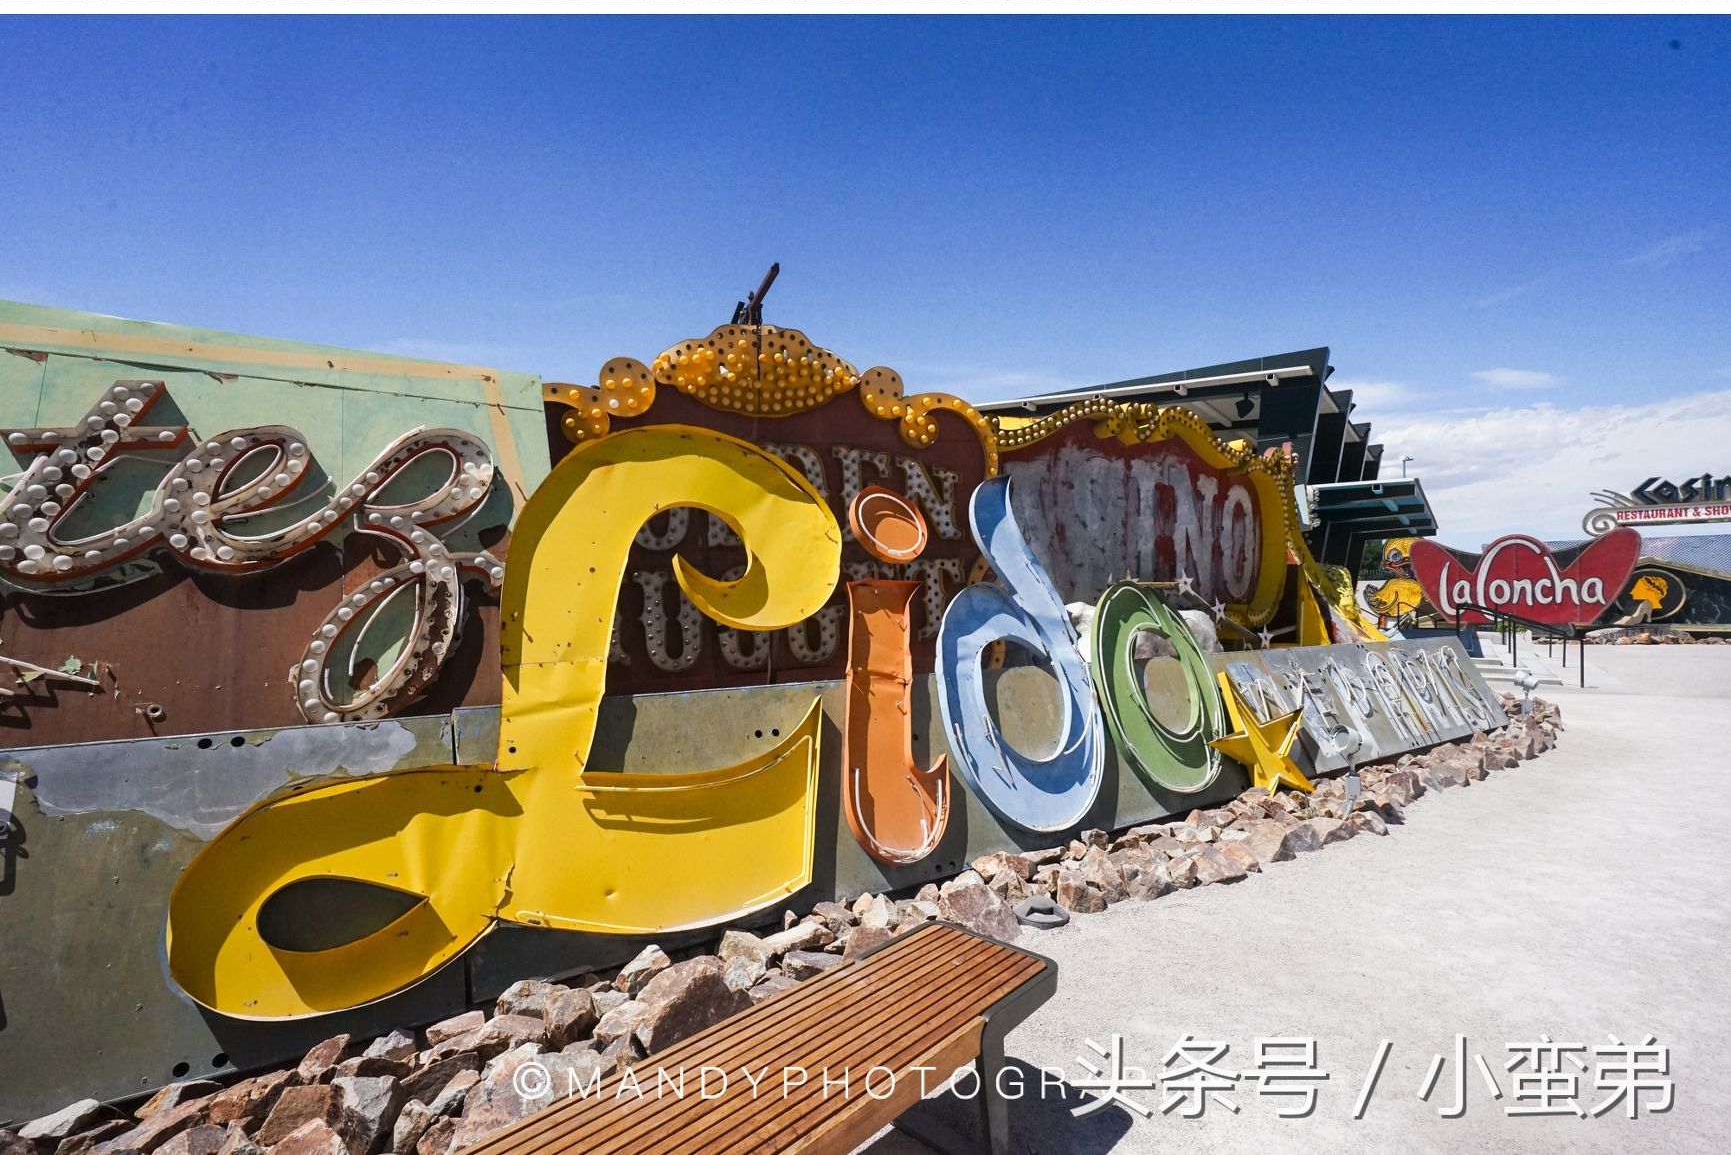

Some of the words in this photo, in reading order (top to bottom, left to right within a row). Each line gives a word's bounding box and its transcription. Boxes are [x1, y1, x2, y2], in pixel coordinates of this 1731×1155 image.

[1616, 508, 1690, 521] RESTAURANT
[1692, 506, 1701, 517] &
[1704, 504, 1731, 517] SHO
